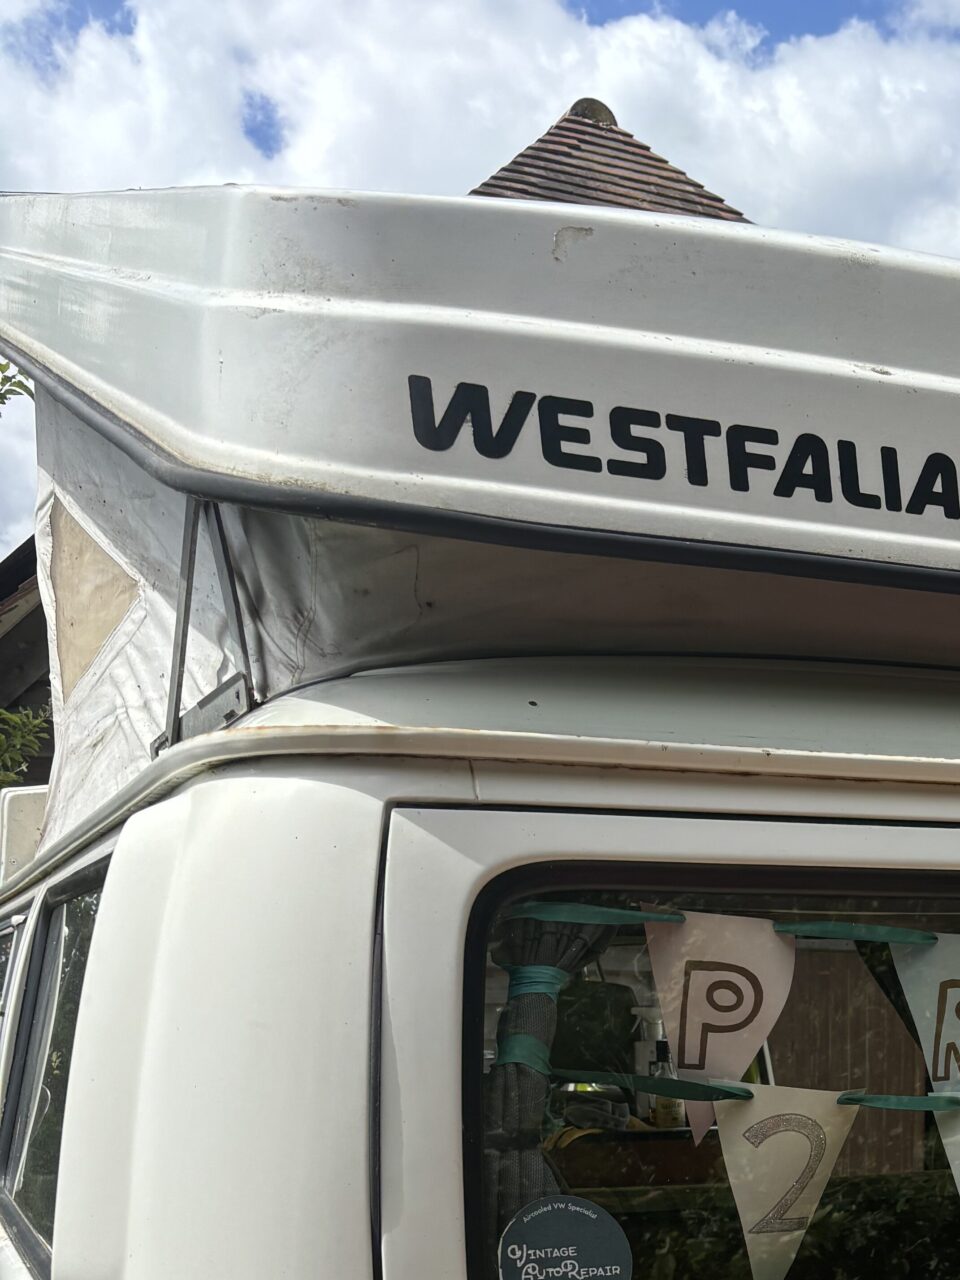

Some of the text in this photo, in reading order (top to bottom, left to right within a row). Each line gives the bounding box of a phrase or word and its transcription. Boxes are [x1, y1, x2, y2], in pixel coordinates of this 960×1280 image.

[407, 374, 960, 520] WESTFALIA
[522, 1203, 552, 1224] Aircooled
[567, 1203, 598, 1220] Specialist
